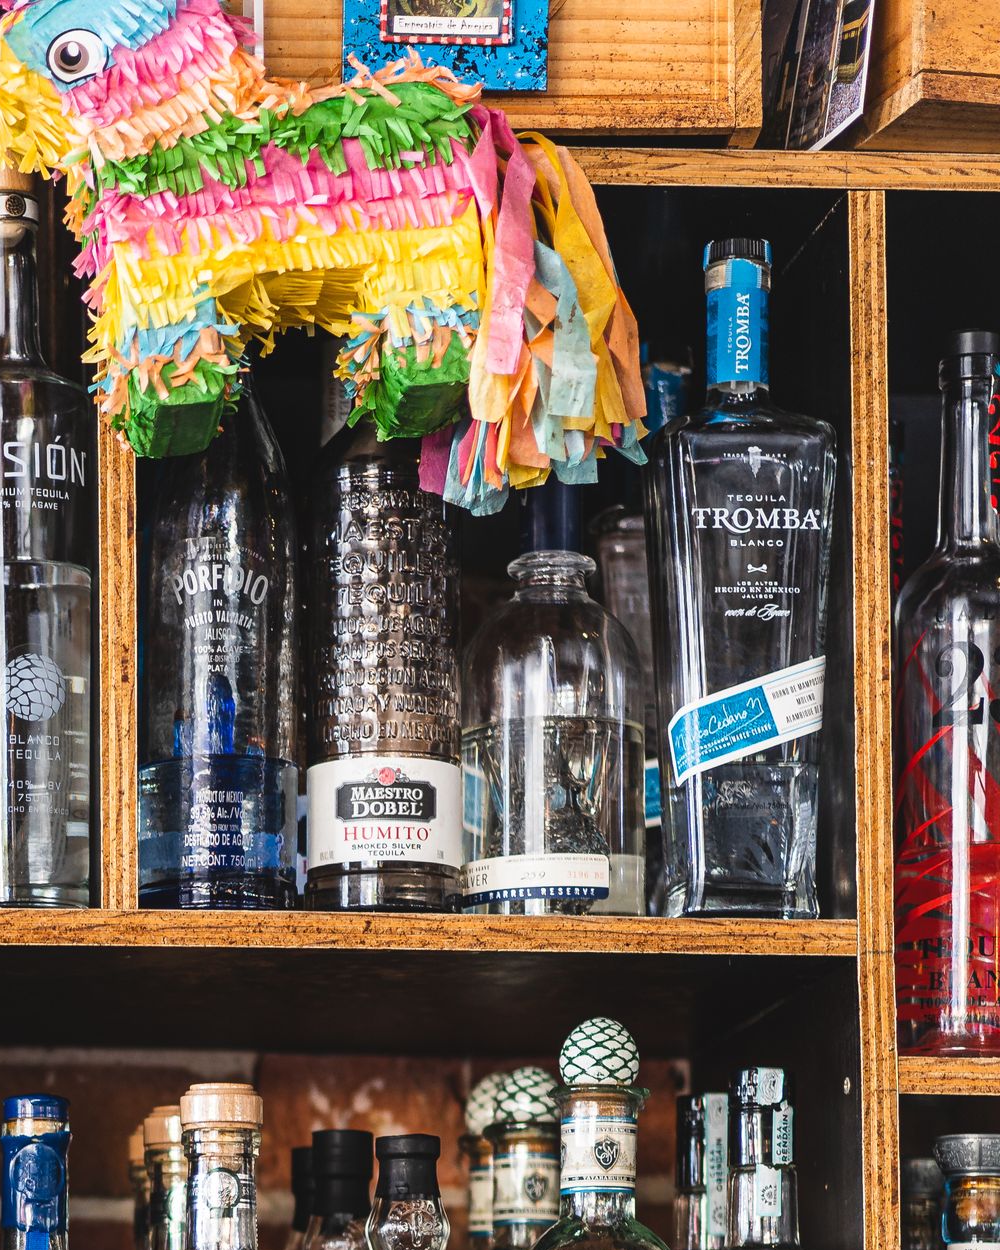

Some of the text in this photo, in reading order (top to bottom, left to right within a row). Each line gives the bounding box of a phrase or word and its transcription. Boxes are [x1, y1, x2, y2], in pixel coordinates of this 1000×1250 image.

[735, 293, 752, 374] TROMBA
[30, 487, 70, 500] TEQUILA
[727, 494, 787, 502] TEQUILA
[31, 500, 59, 510] AGAVE
[691, 507, 821, 534] TROMBA
[730, 539, 784, 547] BLANCO
[172, 563, 269, 606] PORFIDIO
[714, 586, 747, 594] HECHO
[213, 598, 223, 607] IN
[184, 610, 213, 630] PUERTO
[204, 627, 232, 641] JALISCO
[193, 645, 215, 654] 100%
[771, 687, 790, 699] HORNO
[795, 692, 816, 705] MOLINO
[785, 707, 814, 724] ALAMBIQUE
[9, 734, 60, 746] BLANCO
[7, 749, 61, 760] TEQULA
[226, 790, 244, 803] MEXICO
[350, 786, 424, 803] MAESTRO
[351, 801, 423, 818] DOBEL
[232, 833, 254, 847] AGAVE
[343, 826, 429, 842] HUMITO
[351, 842, 422, 851] SMOKED SILVER
[230, 854, 245, 867] 750
[489, 888, 596, 900] BARREL RESERVE
